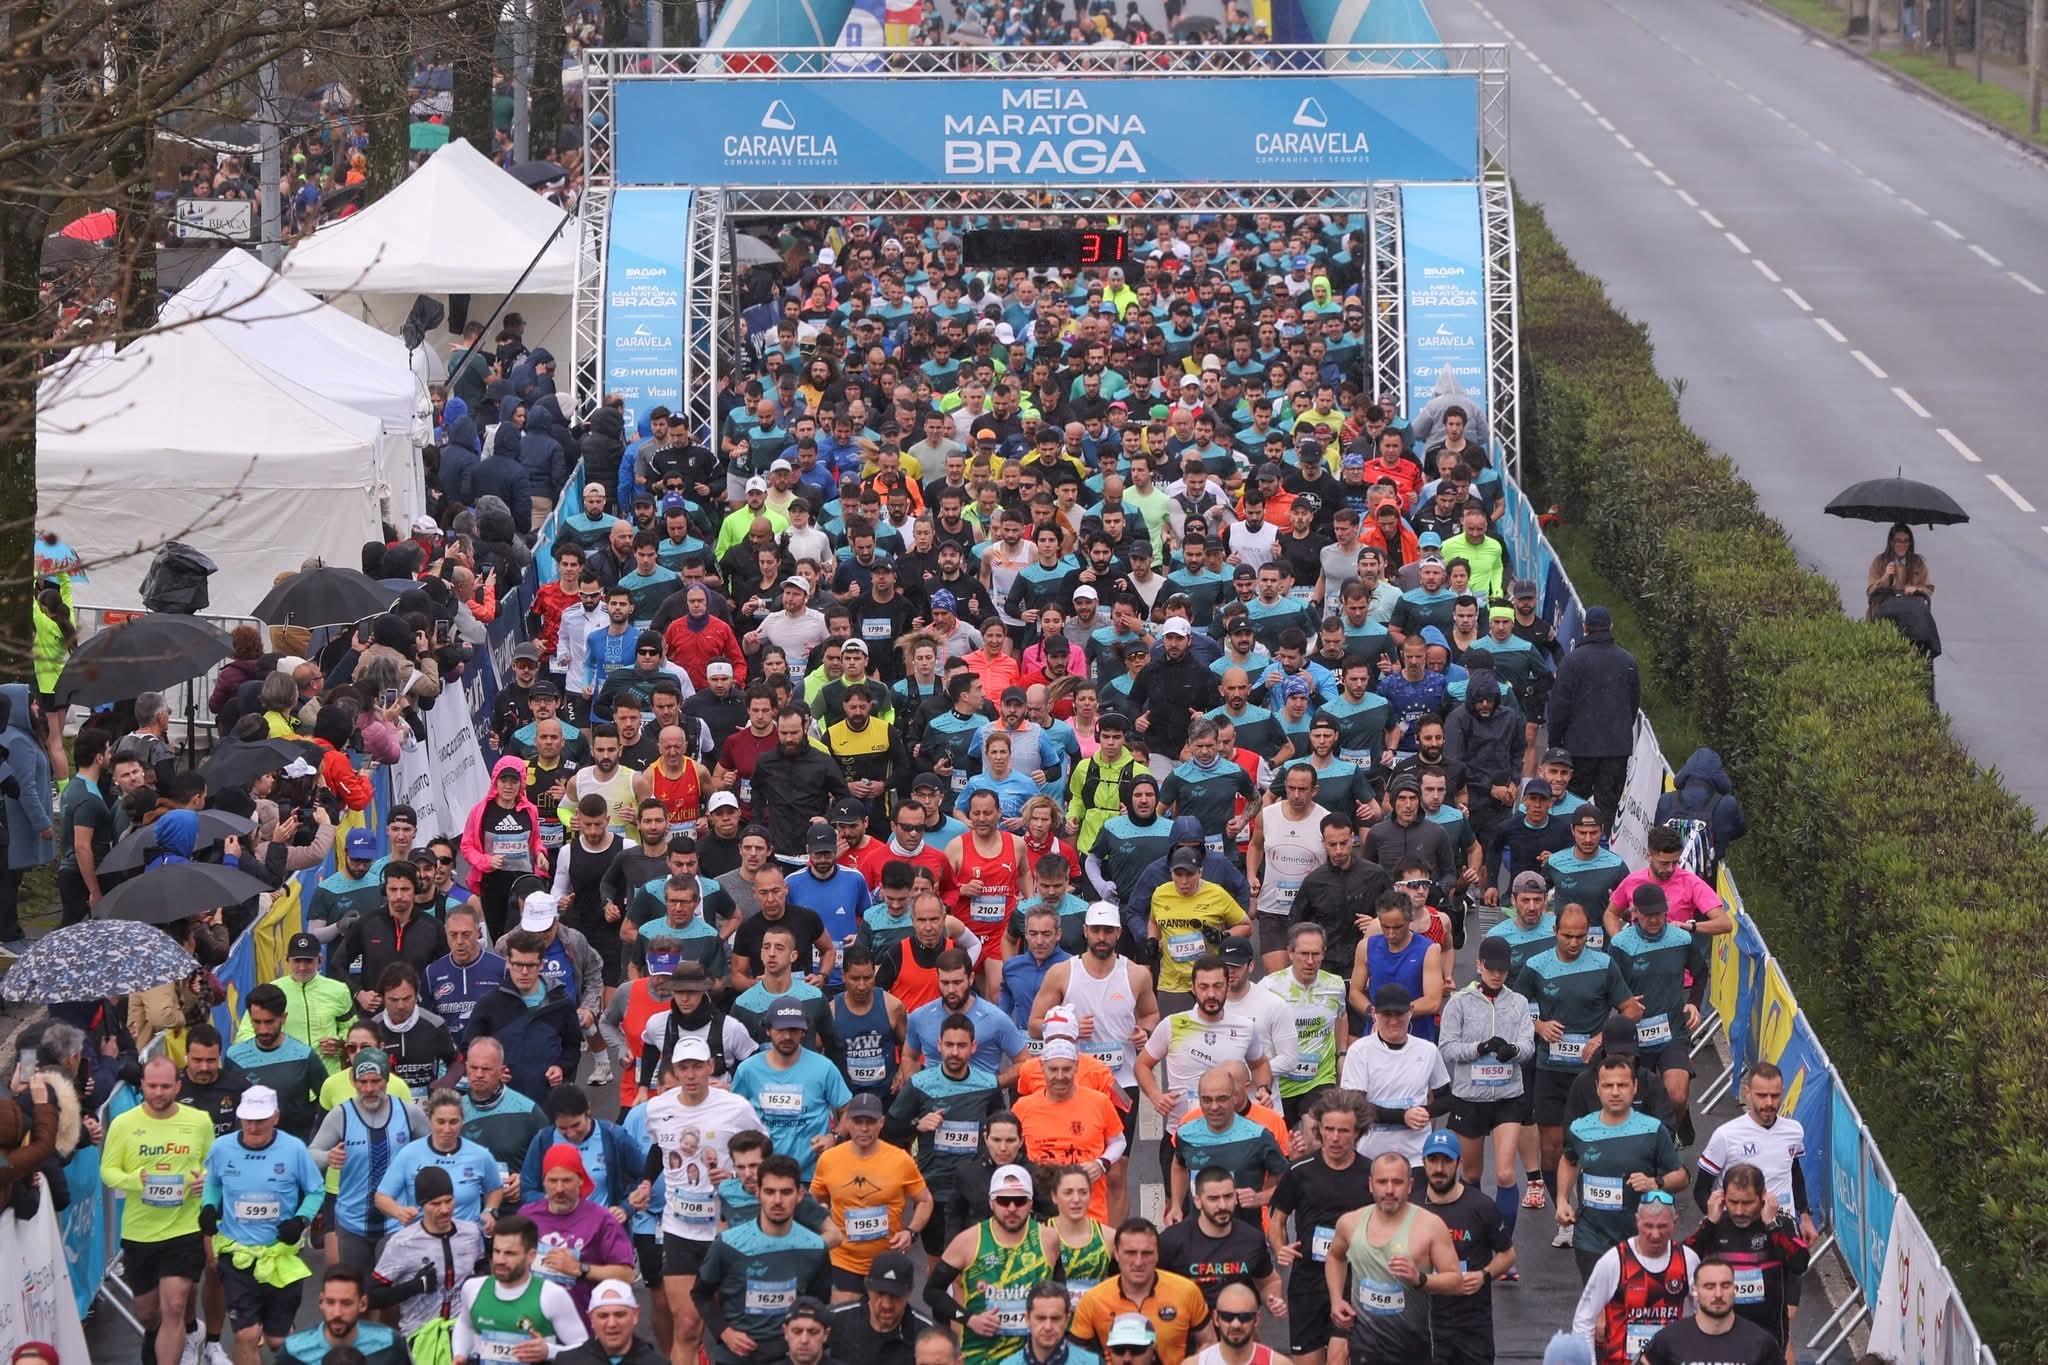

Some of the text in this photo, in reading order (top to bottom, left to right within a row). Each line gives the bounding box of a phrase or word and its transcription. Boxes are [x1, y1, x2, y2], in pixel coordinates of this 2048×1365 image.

[1002, 88, 1088, 110] MEIA
[945, 114, 1146, 135] MARATONA
[724, 135, 838, 157] CARAVELA
[1255, 132, 1369, 154] CARAVELA
[724, 158, 839, 166] COMPANHIA DE SEGUROS
[945, 140, 1146, 175] BRAGA
[1313, 156, 1323, 164] DE
[1330, 156, 1369, 164] SEGUROS
[611, 296, 677, 307] BRAGA
[1411, 296, 1478, 306] BRAGA
[615, 337, 672, 347] CARAVELA
[1418, 336, 1475, 346] CARAVELA
[631, 368, 677, 377] HYUNDAI
[648, 385, 677, 398] Vitalis
[541, 834, 556, 842] 807
[977, 906, 999, 915] 2102
[1175, 943, 1195, 953] 1753
[777, 1007, 802, 1017] adidas
[1641, 1026, 1660, 1038] 1791
[1558, 1043, 1580, 1053] 1539
[854, 1069, 875, 1077] 1612
[1481, 1066, 1504, 1075] 1650
[768, 1095, 792, 1105] 1652
[944, 1131, 969, 1142] 1938
[139, 1143, 190, 1156] RunFun
[1743, 1143, 1756, 1155] M
[149, 1186, 173, 1196] 1760
[1590, 1187, 1611, 1199] 1659
[245, 1205, 268, 1215] 599
[680, 1202, 703, 1213] 1708
[854, 1218, 879, 1230] 1963
[757, 1293, 785, 1304] 1629
[1370, 1293, 1392, 1304] 568
[493, 1344, 511, 1354] 192
